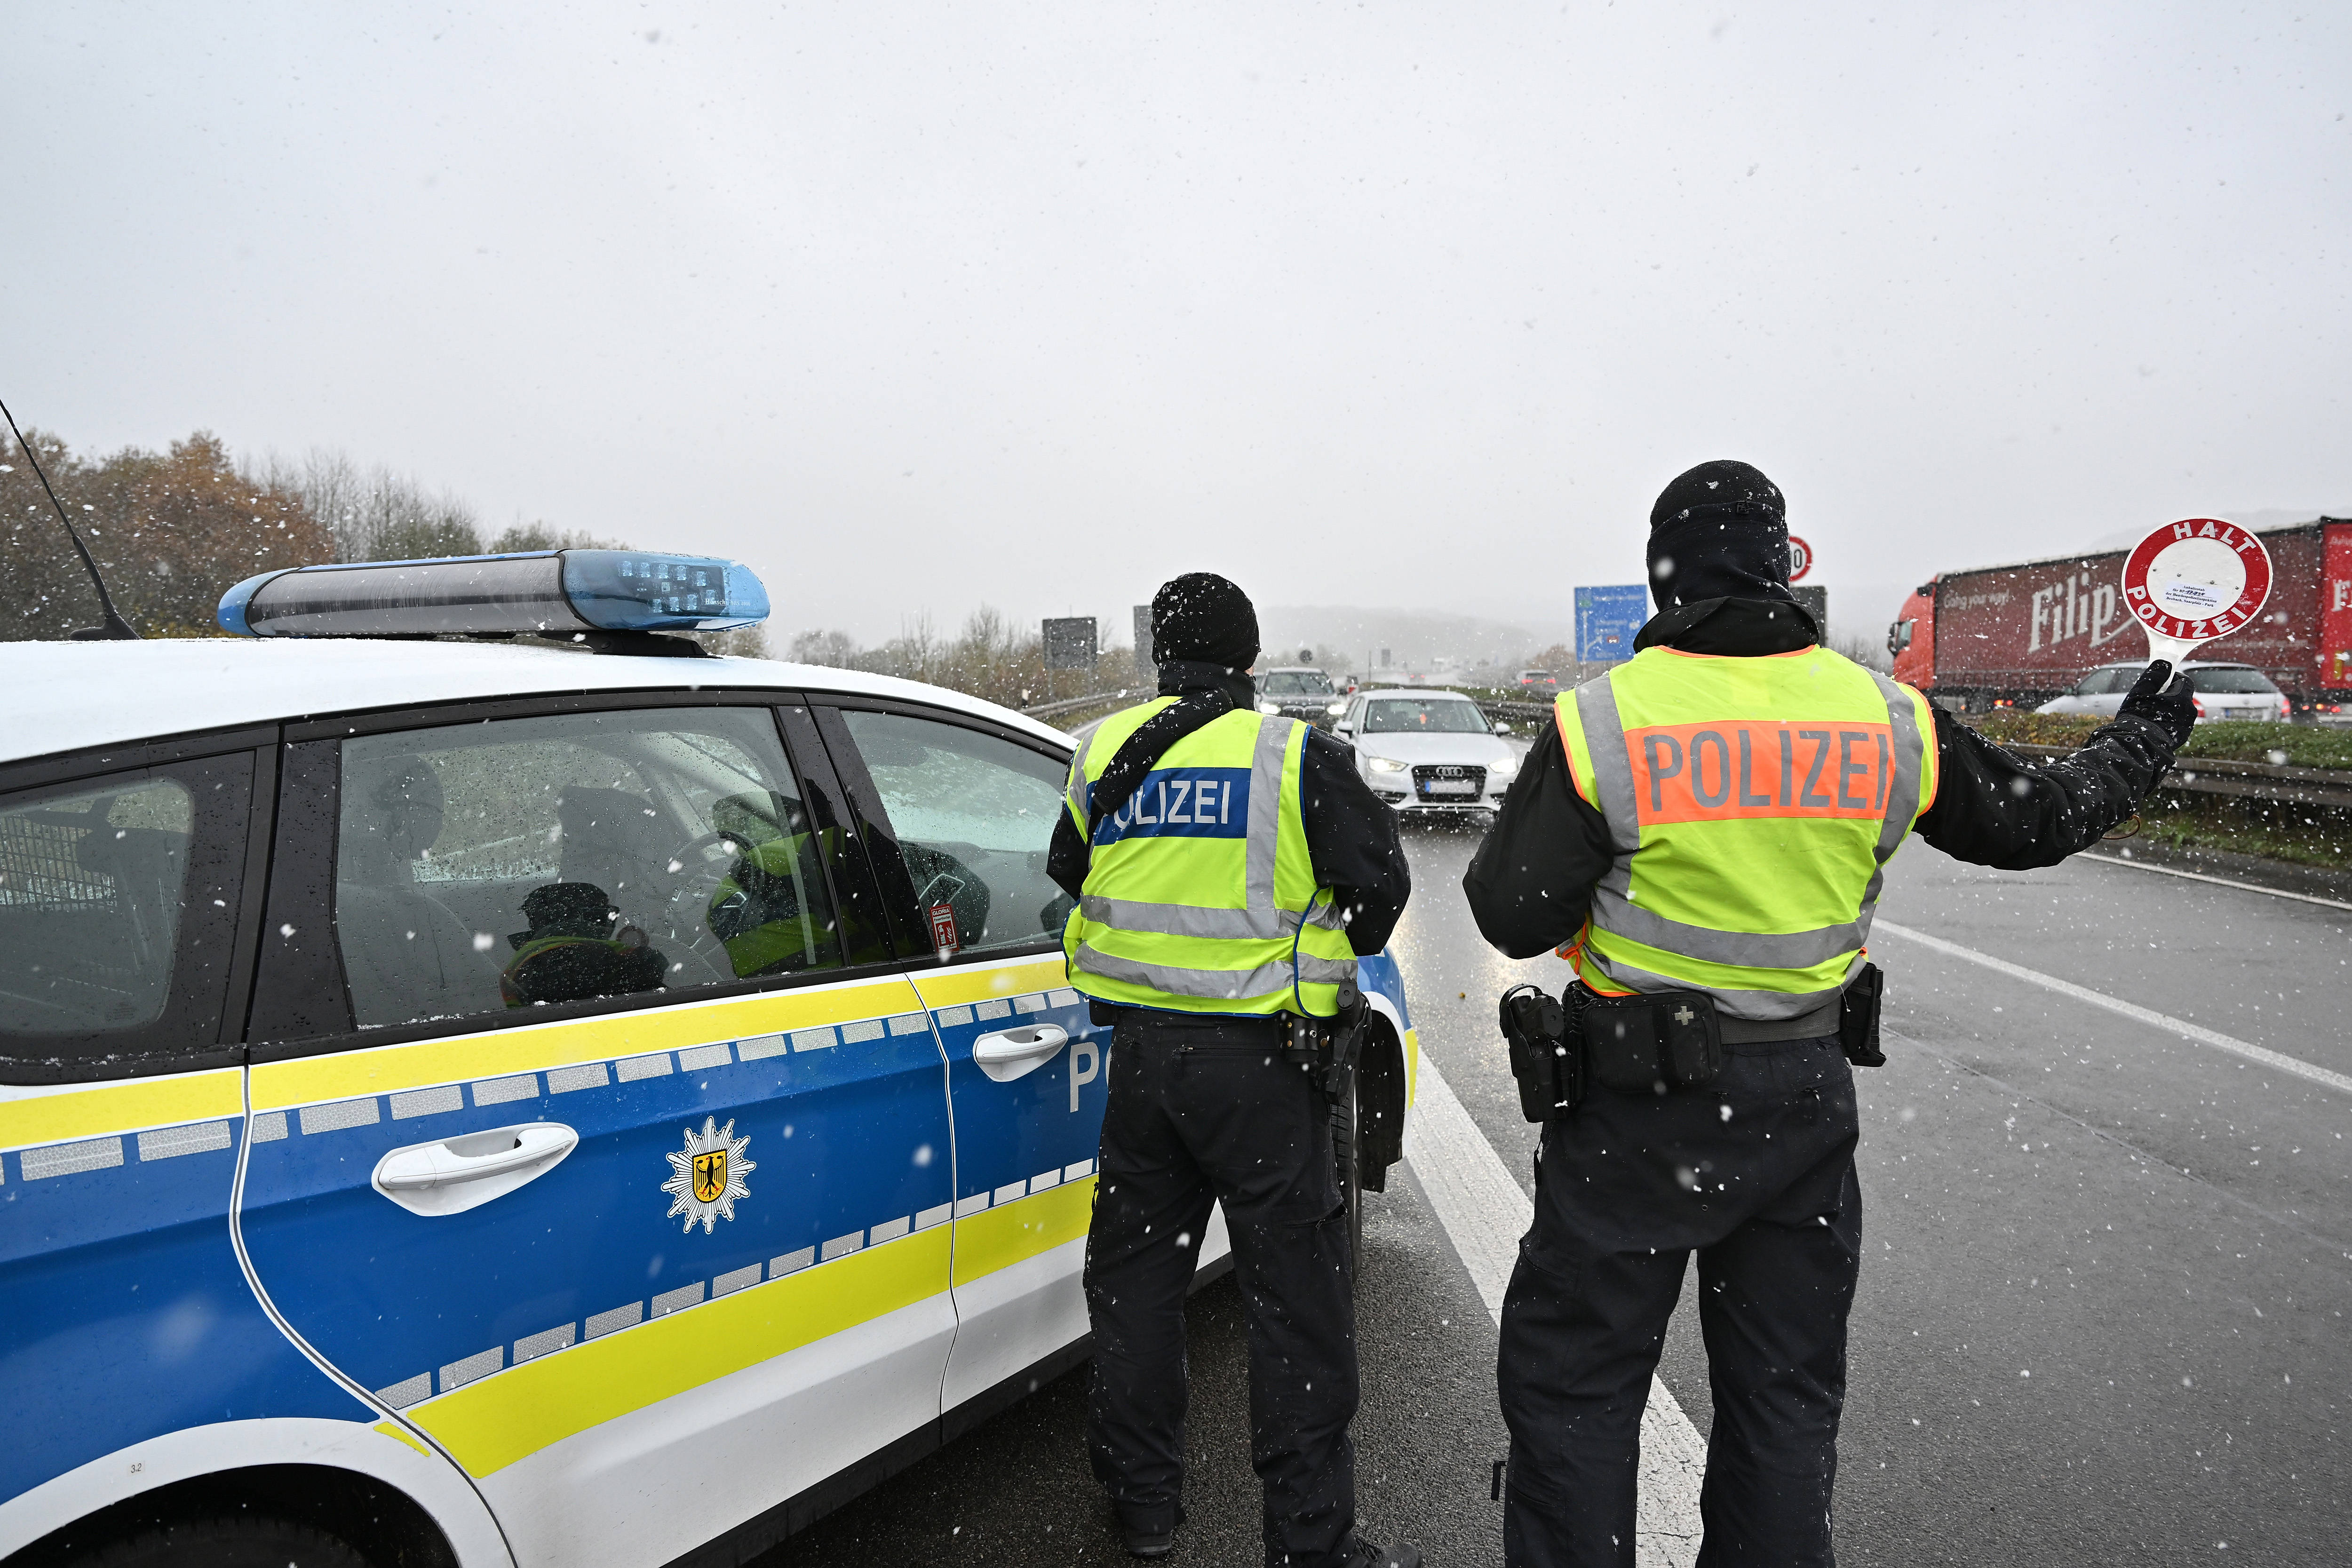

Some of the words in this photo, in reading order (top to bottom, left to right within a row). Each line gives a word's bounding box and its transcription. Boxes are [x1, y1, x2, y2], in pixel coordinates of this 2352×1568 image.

[2173, 521, 2257, 553] HALT
[2027, 572, 2116, 653] Filip
[2127, 585, 2248, 638] POLIZEI
[1644, 730, 1889, 812] POLIZEI
[1098, 780, 1231, 833] OLIZEI
[1070, 1042, 1112, 1113] P
